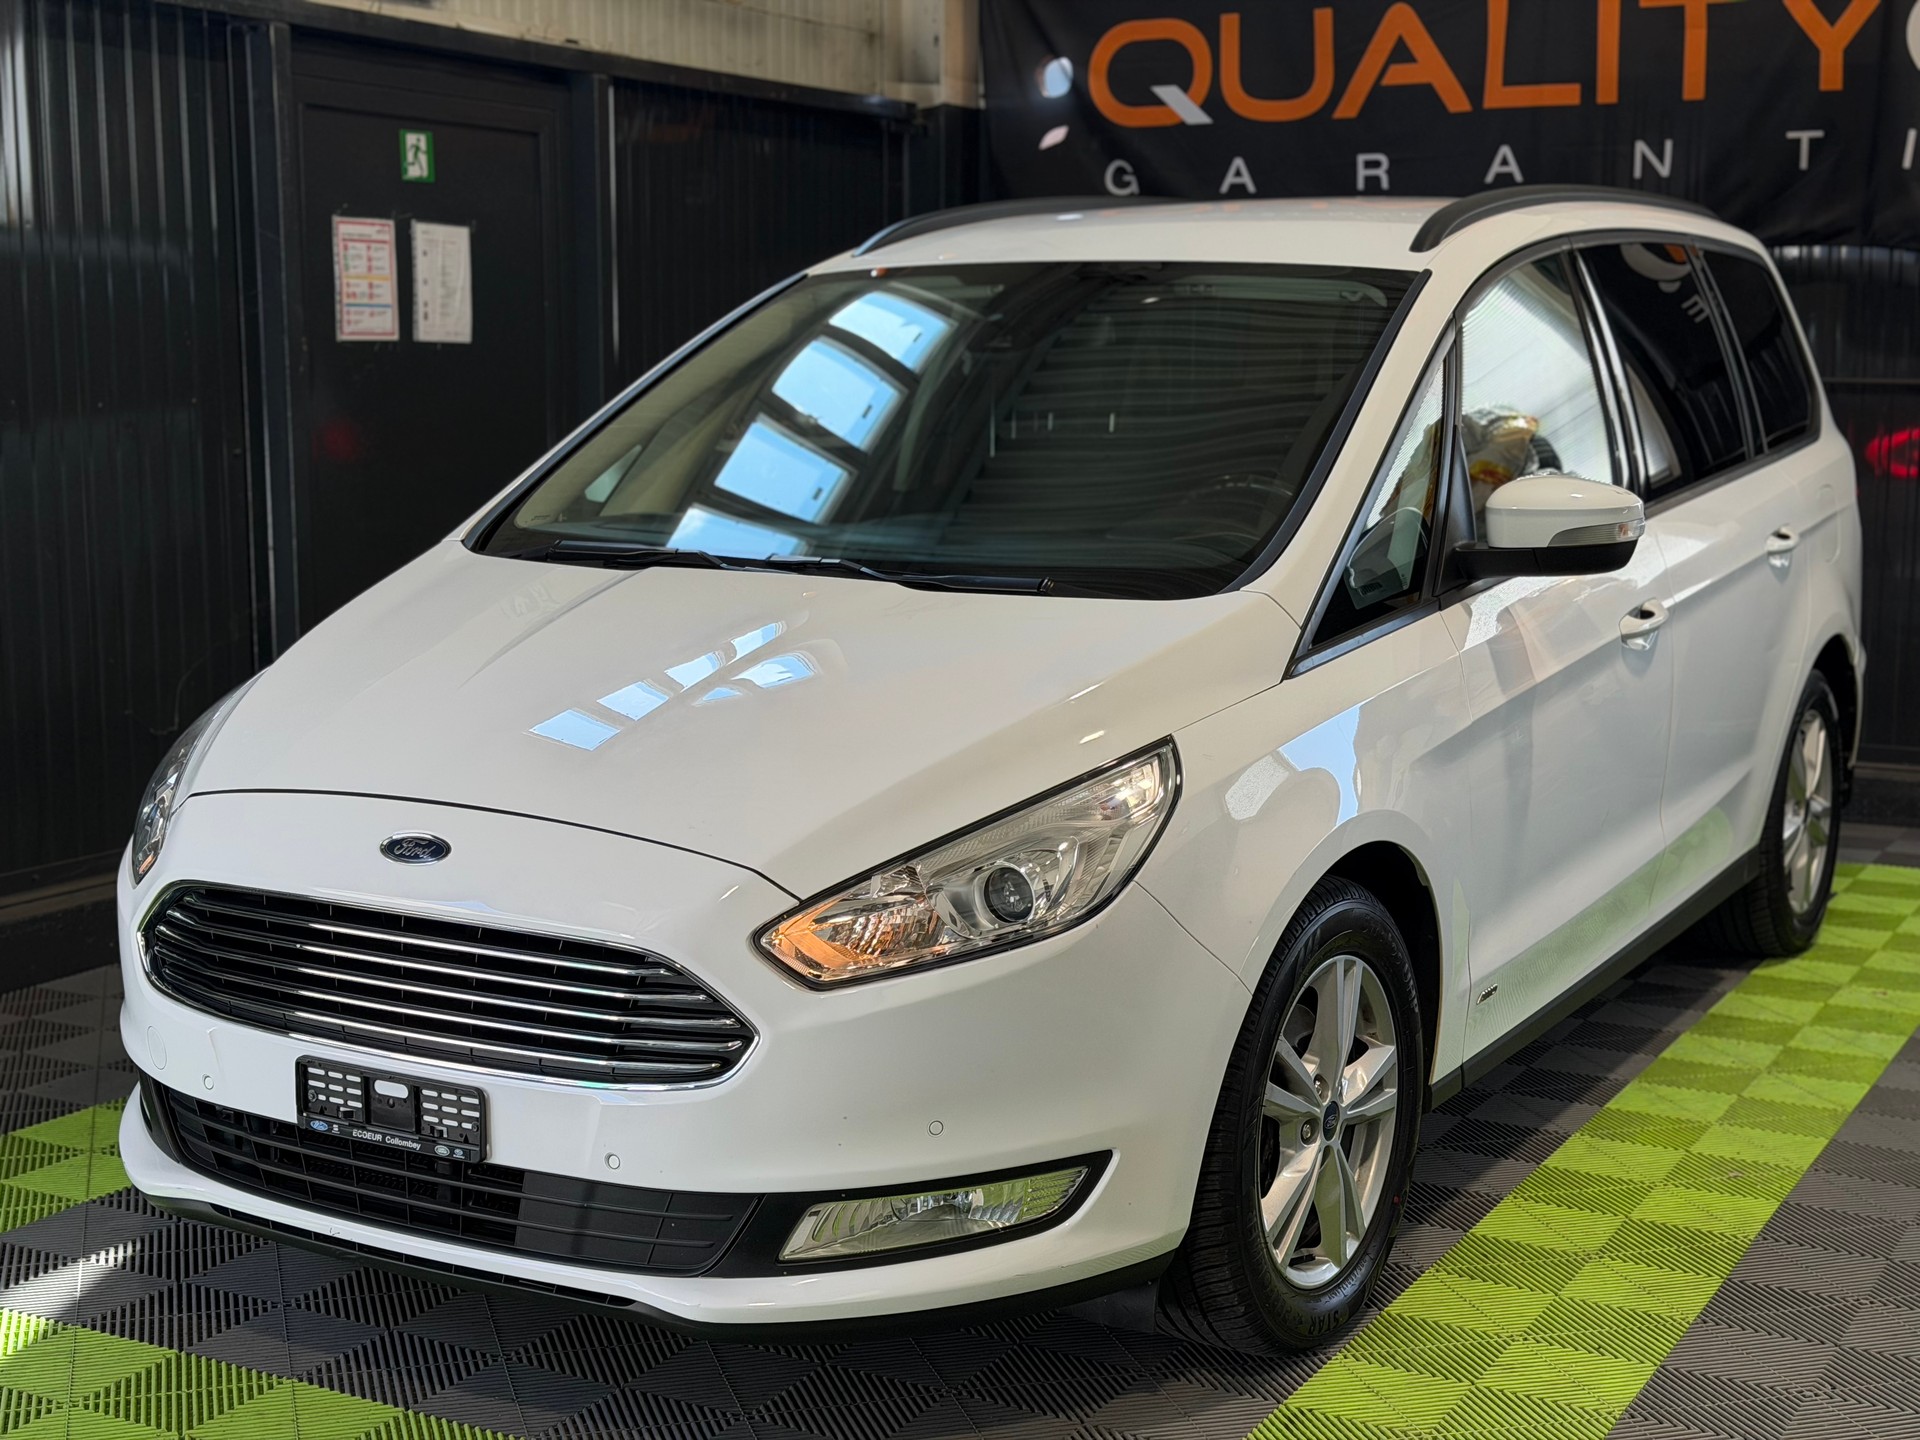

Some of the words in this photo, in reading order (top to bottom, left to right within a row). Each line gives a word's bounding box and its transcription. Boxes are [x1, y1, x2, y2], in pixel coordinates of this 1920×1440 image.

[1088, 0, 1881, 127] QUALITY
[393, 838, 437, 859] Ford
[352, 1129, 383, 1142] ECOEUR
[385, 1136, 422, 1151] Collombey
